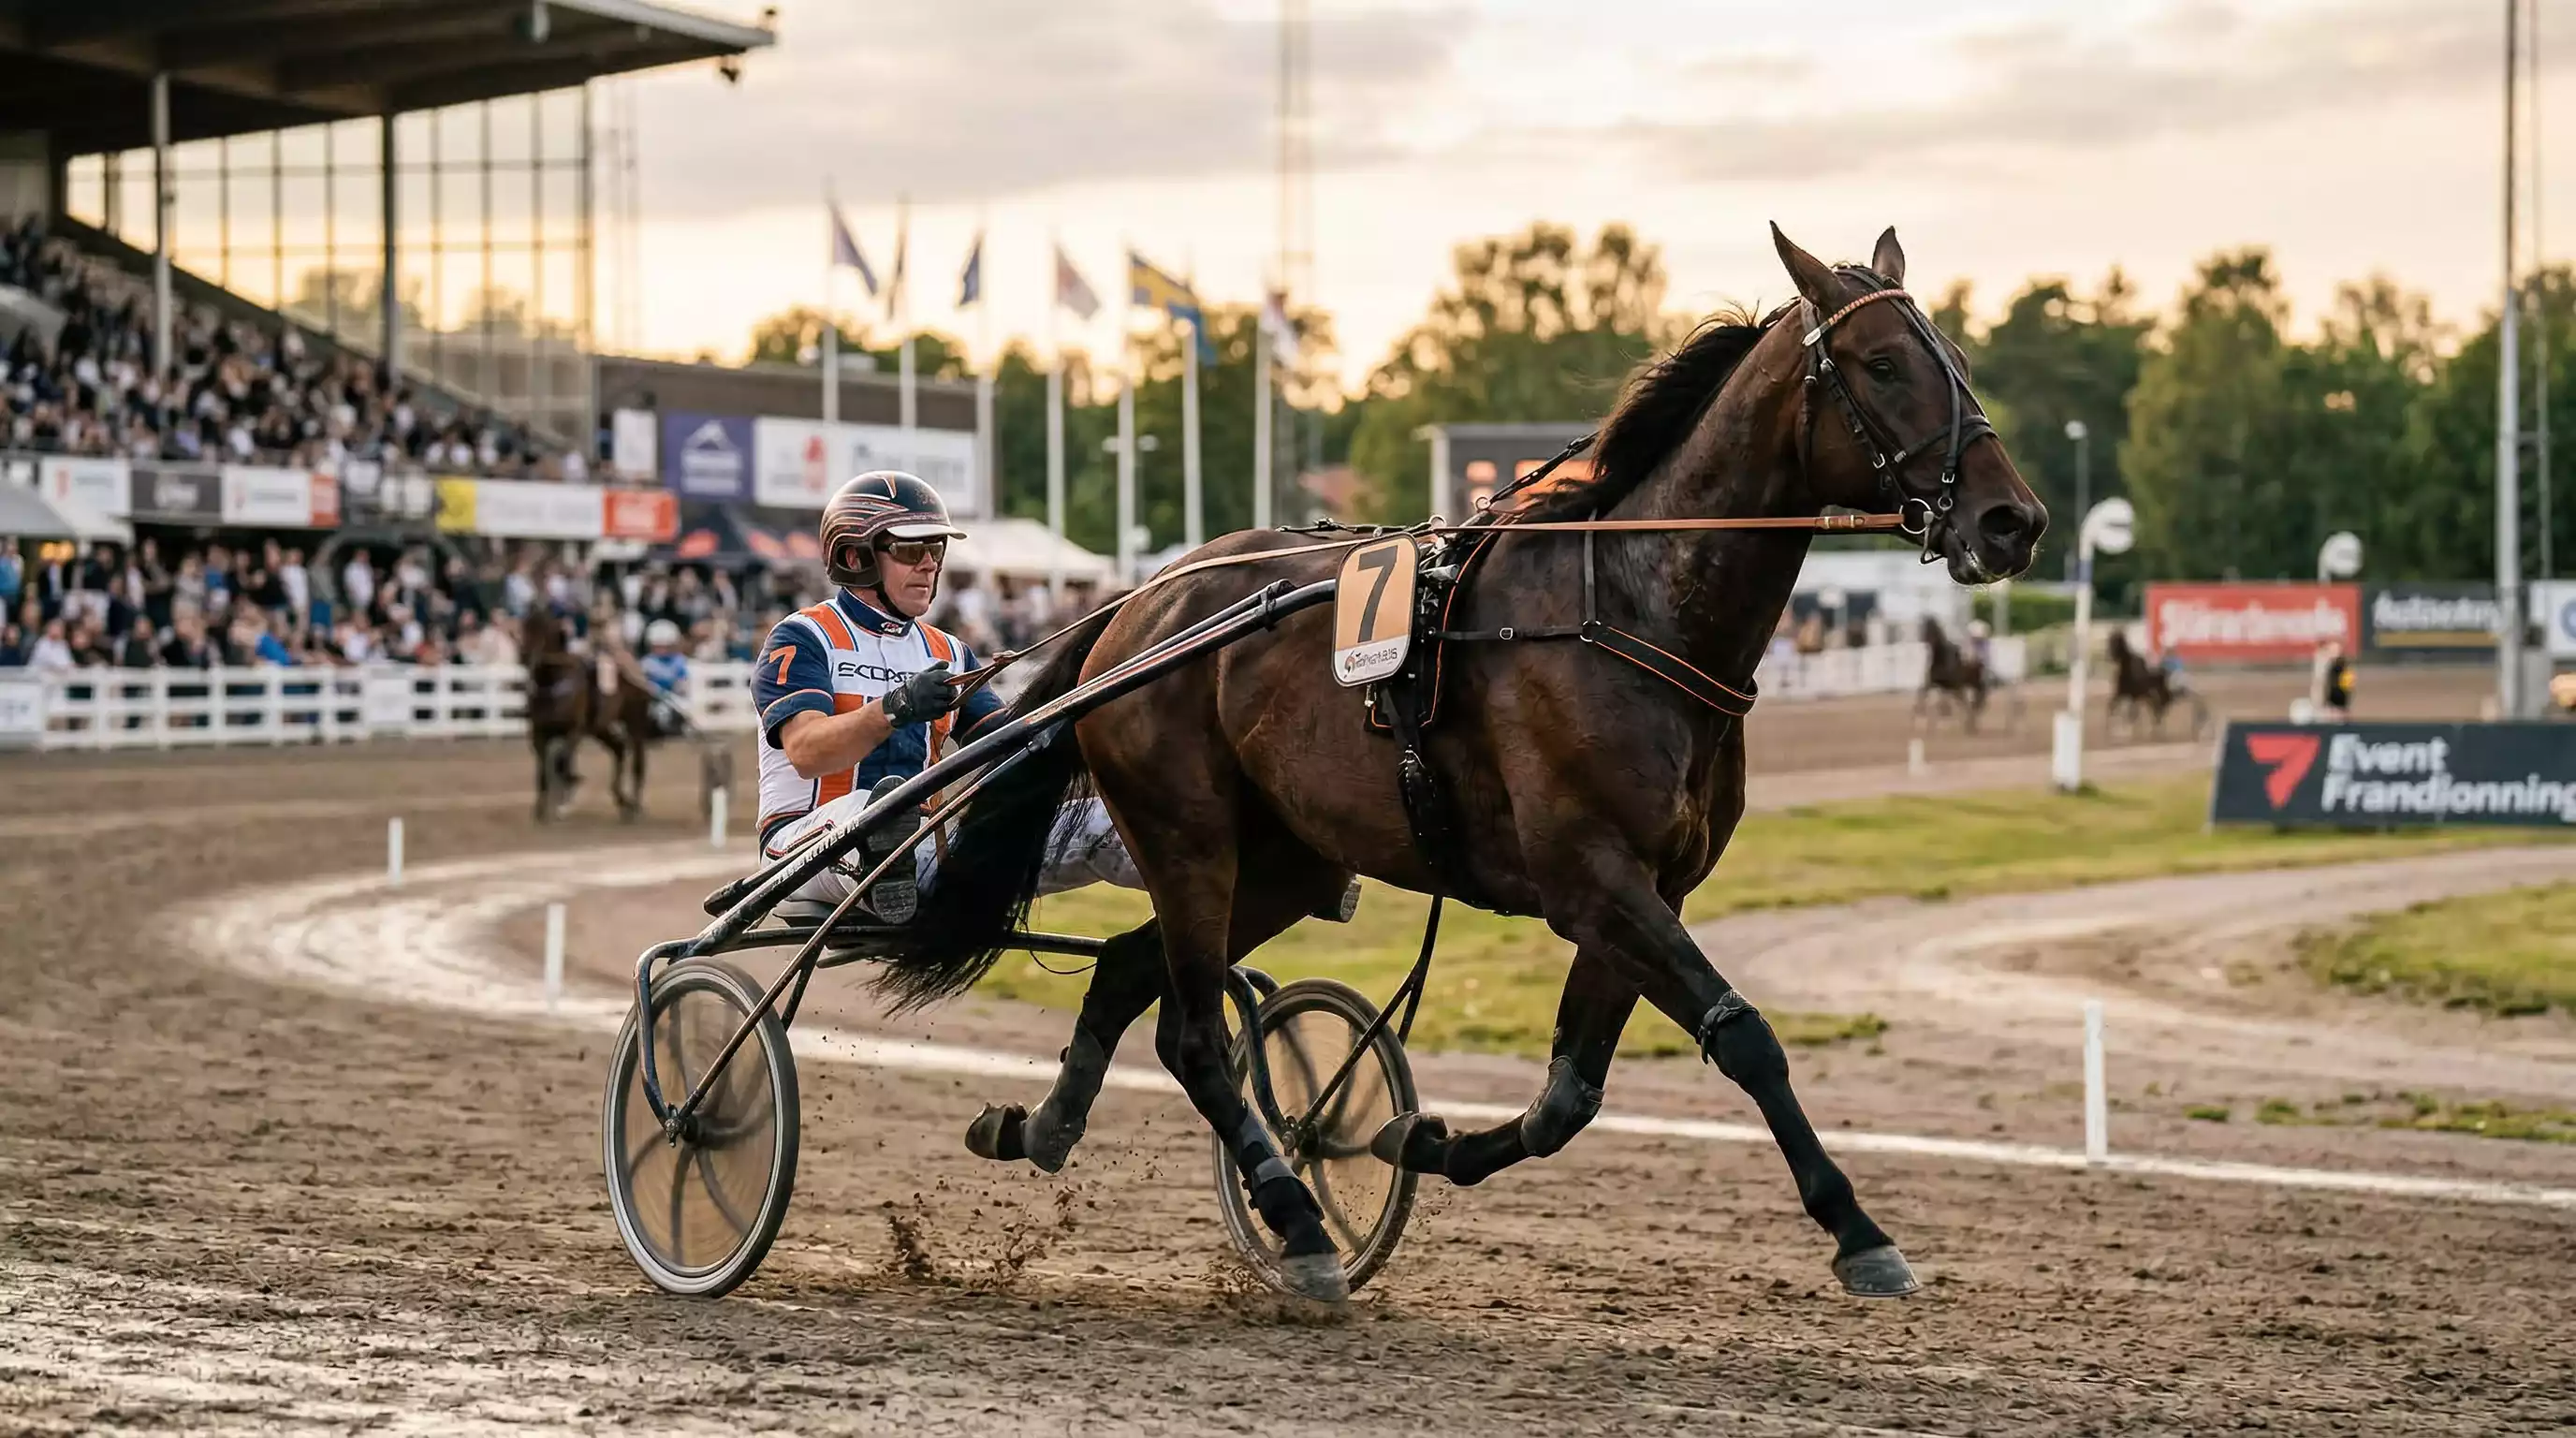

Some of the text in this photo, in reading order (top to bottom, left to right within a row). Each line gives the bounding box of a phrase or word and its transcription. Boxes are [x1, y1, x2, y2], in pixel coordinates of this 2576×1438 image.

[1357, 545, 1398, 643] 7
[769, 645, 797, 684] 7
[2329, 733, 2450, 774] Event
